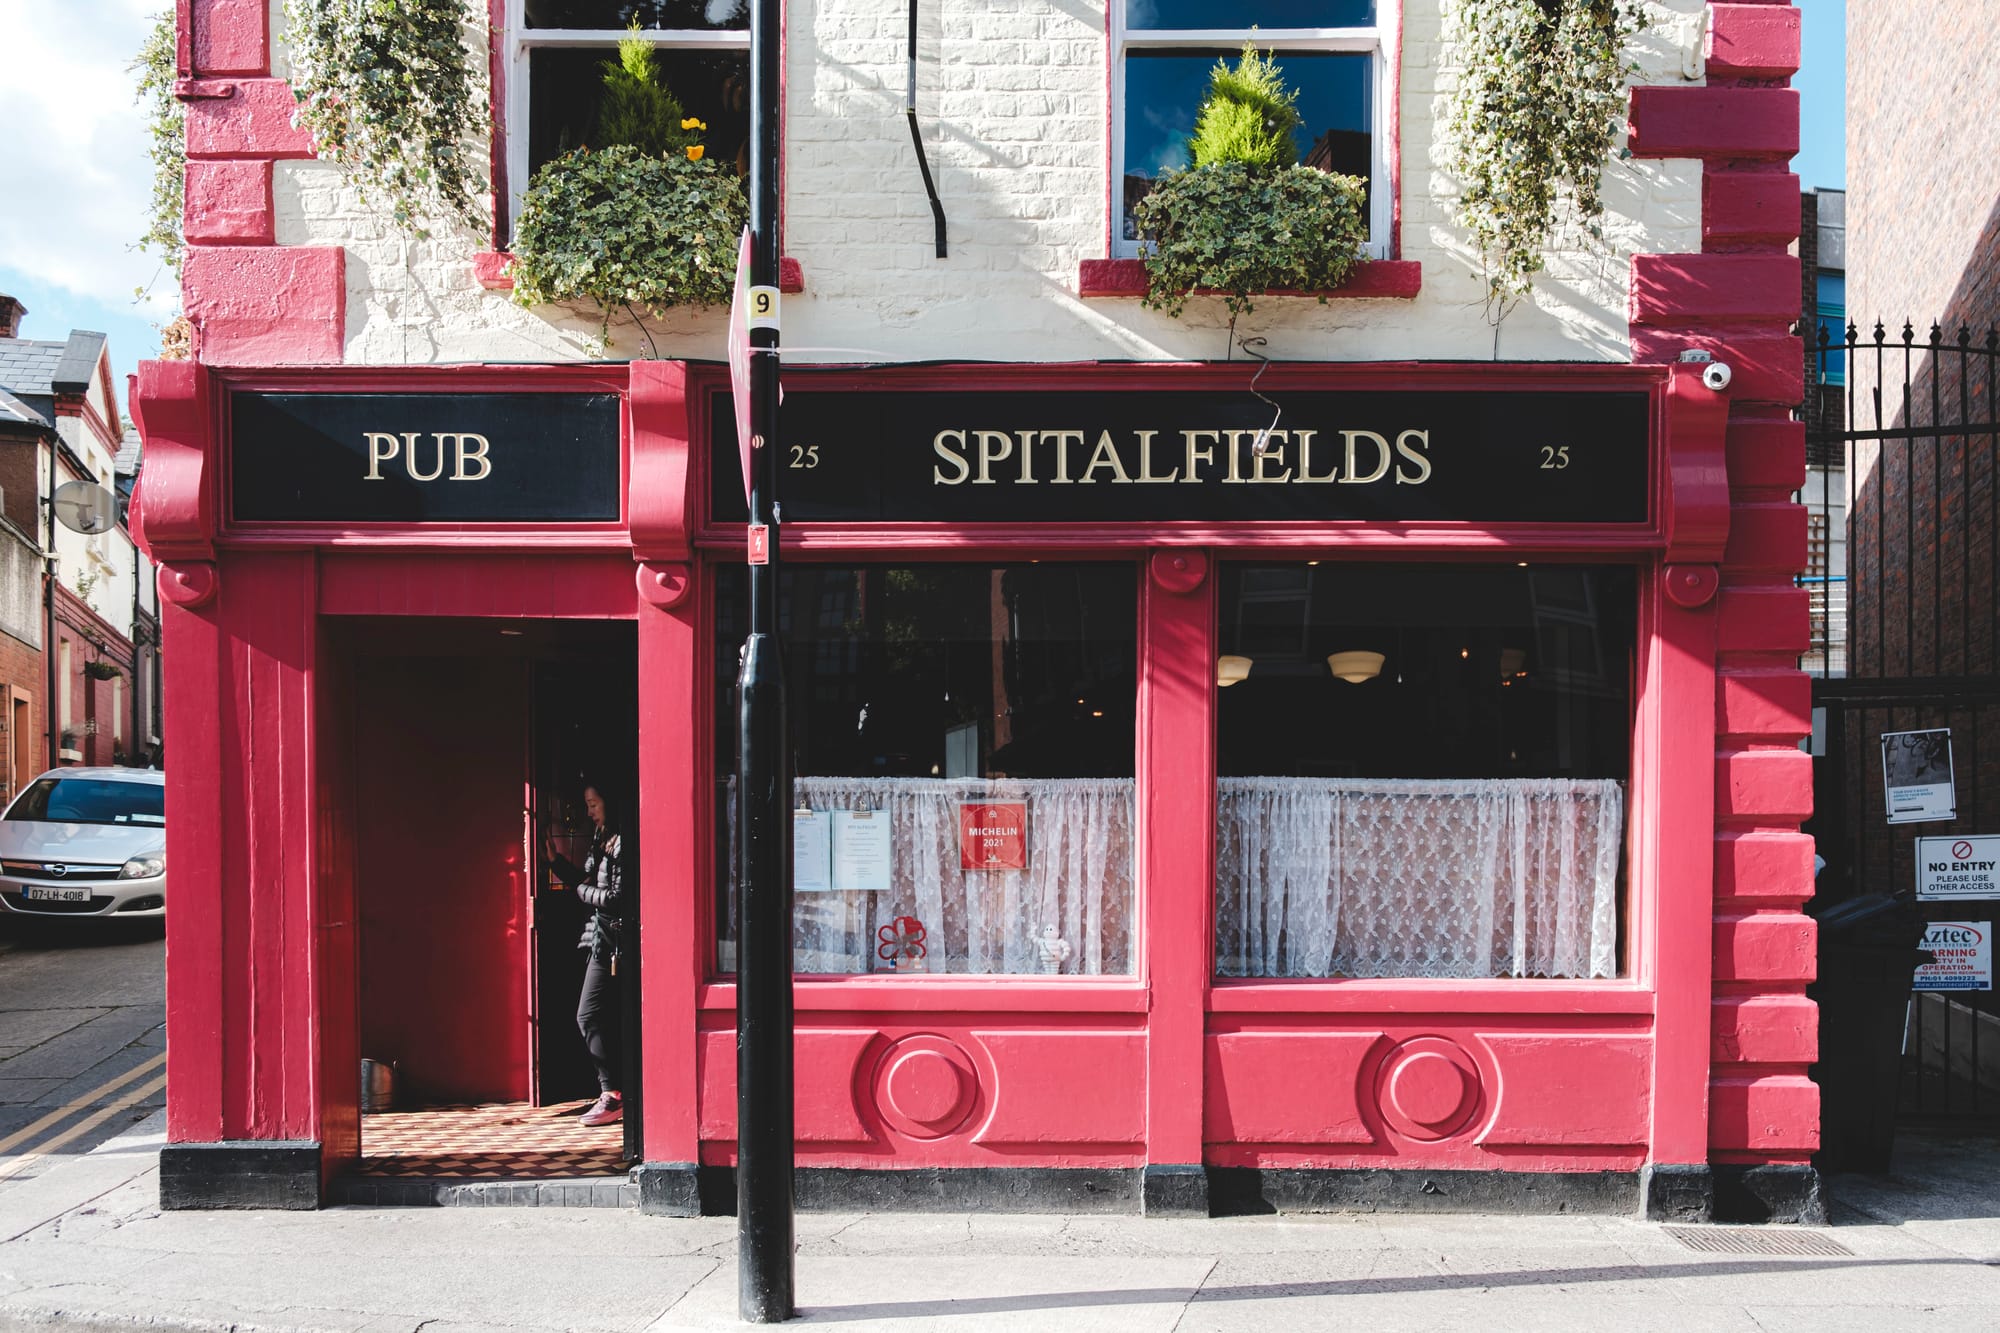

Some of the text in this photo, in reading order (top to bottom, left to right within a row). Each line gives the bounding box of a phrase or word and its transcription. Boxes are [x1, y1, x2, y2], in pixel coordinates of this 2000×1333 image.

[756, 293, 770, 313] 9
[363, 432, 492, 481] PUB
[789, 445, 820, 469] 25
[932, 428, 1432, 486] SPITALFIELDS
[1539, 446, 1570, 470] 25
[968, 826, 1018, 836] MICHELIN
[983, 838, 1004, 847] 2021
[1928, 861, 1996, 872] NO ENTRY
[1936, 874, 1989, 883] PLEASE USE
[1928, 882, 1995, 891] OTHER ACCESS
[31, 889, 84, 901] 07-LH-4018
[1931, 949, 1977, 957] ARNING
